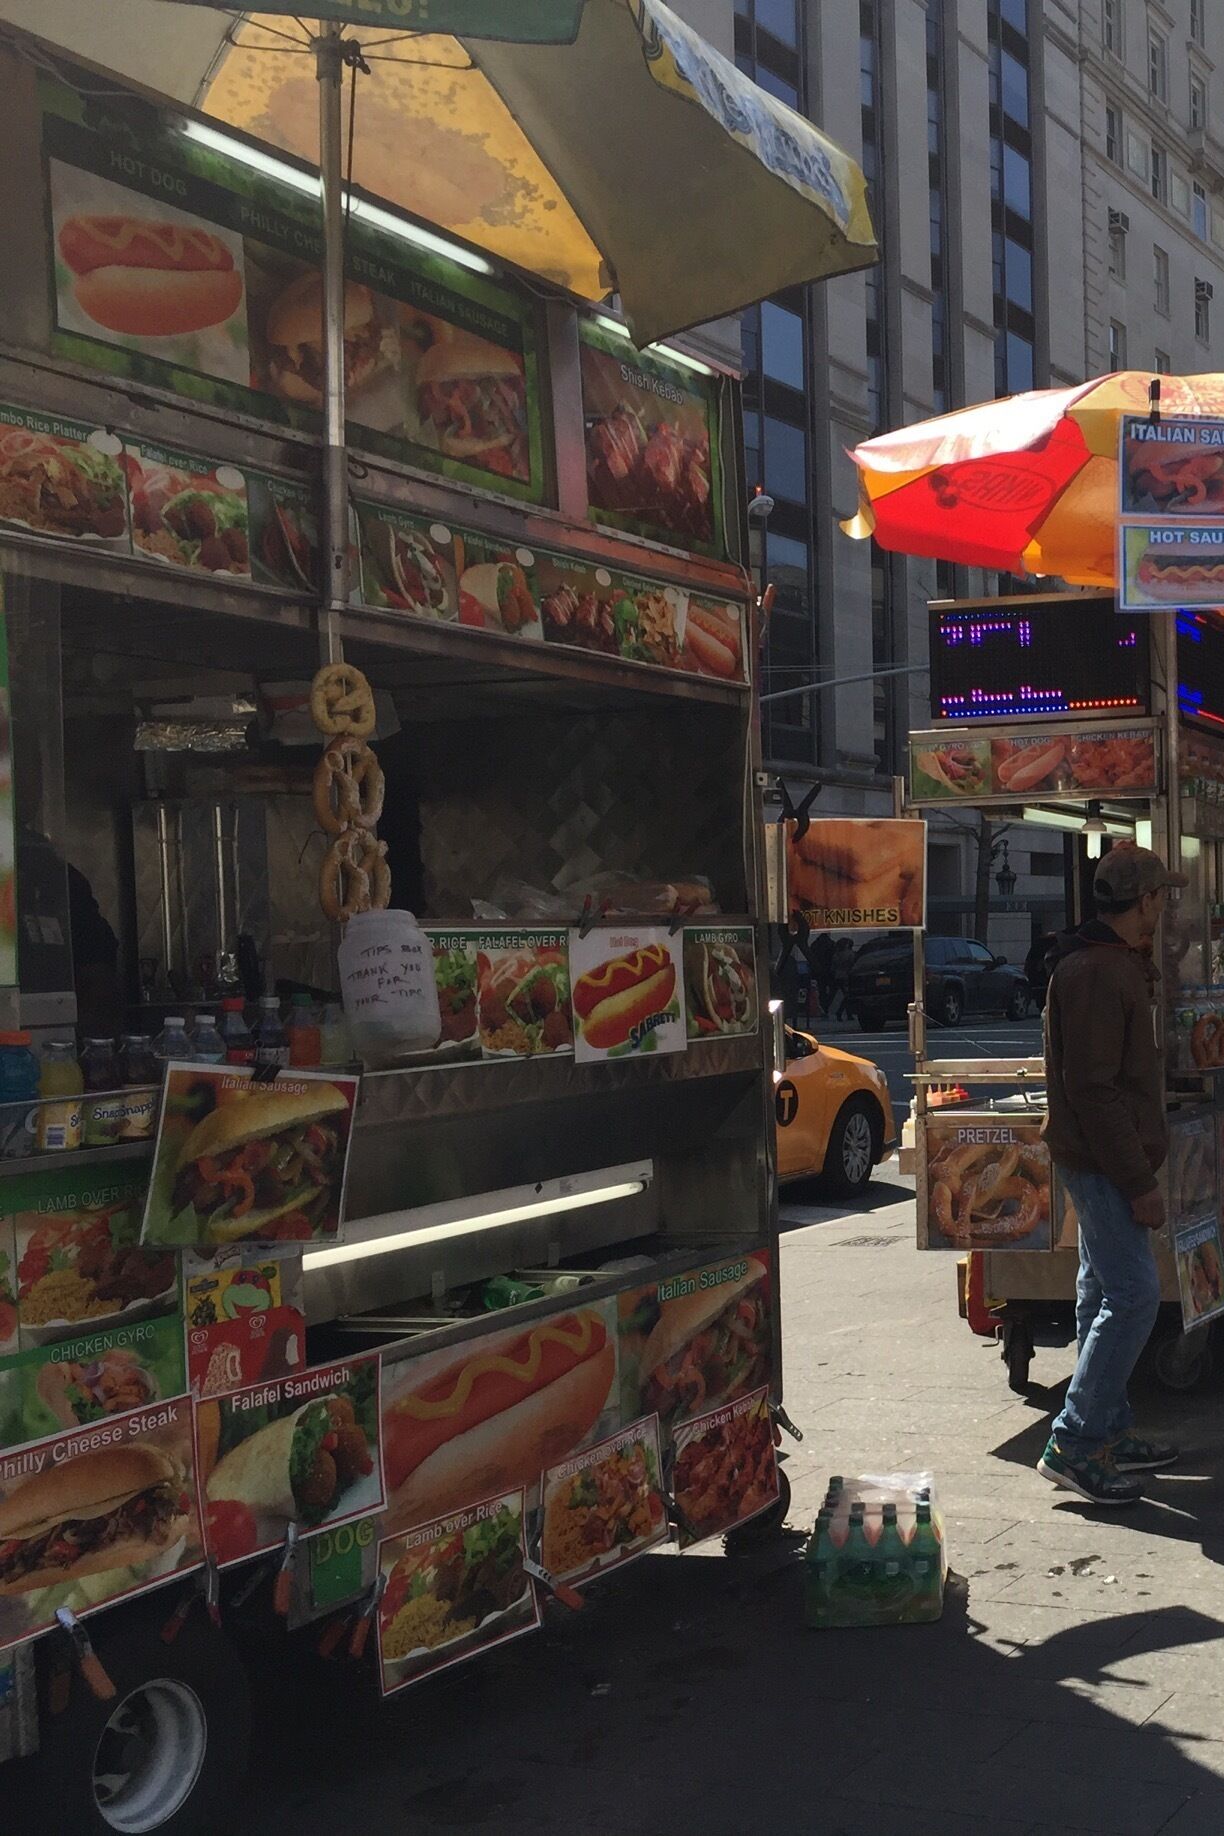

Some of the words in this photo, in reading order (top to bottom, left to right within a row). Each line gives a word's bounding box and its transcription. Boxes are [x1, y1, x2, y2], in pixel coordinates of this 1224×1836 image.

[110, 150, 147, 180] HOT
[152, 169, 187, 197] DOG
[240, 206, 289, 239] PHILLY
[293, 229, 323, 254] CHE
[352, 255, 396, 288] STEAK
[457, 303, 509, 338] SAUSAGE
[620, 363, 651, 390] Shish
[652, 377, 685, 405] Kebab
[26, 414, 50, 432] Rice
[53, 422, 88, 442] Platter
[1130, 423, 1195, 443] ITALIAN
[188, 460, 208, 476] Rice
[1150, 531, 1184, 543] HOT
[1009, 736, 1029, 746] HOT
[1031, 736, 1051, 746] DOG
[1076, 733, 1115, 743] CHICKEN
[801, 909, 821, 923] OT
[824, 907, 898, 924] KNISHES
[360, 944, 392, 958] TIPS
[439, 936, 467, 950] RICE
[478, 936, 526, 949] FALAFEL
[527, 936, 557, 949] OVER
[609, 936, 622, 947] Hot
[624, 936, 639, 948] Dog
[694, 932, 716, 944] LAMB
[718, 932, 739, 944] GYRO
[629, 1011, 678, 1049] SABRETT
[221, 1075, 256, 1090] Italian
[260, 1080, 308, 1096] Sausage
[780, 1089, 794, 1121] T
[957, 1128, 1017, 1143] PRETZEL
[38, 1194, 78, 1214] LAMB
[81, 1186, 120, 1206] OVER
[657, 1279, 696, 1302] Italian
[699, 1261, 748, 1289] Sausage
[51, 1331, 113, 1364] CHICKEN
[231, 1384, 281, 1413] Falafel
[284, 1366, 350, 1399] Sandwich
[52, 1420, 123, 1461] Cheese
[128, 1405, 178, 1435] Steak
[692, 1410, 731, 1435] Chicken
[405, 1523, 443, 1550] Lamb
[444, 1512, 474, 1536] over
[476, 1501, 502, 1523] Rice
[314, 1516, 375, 1565] DOG
